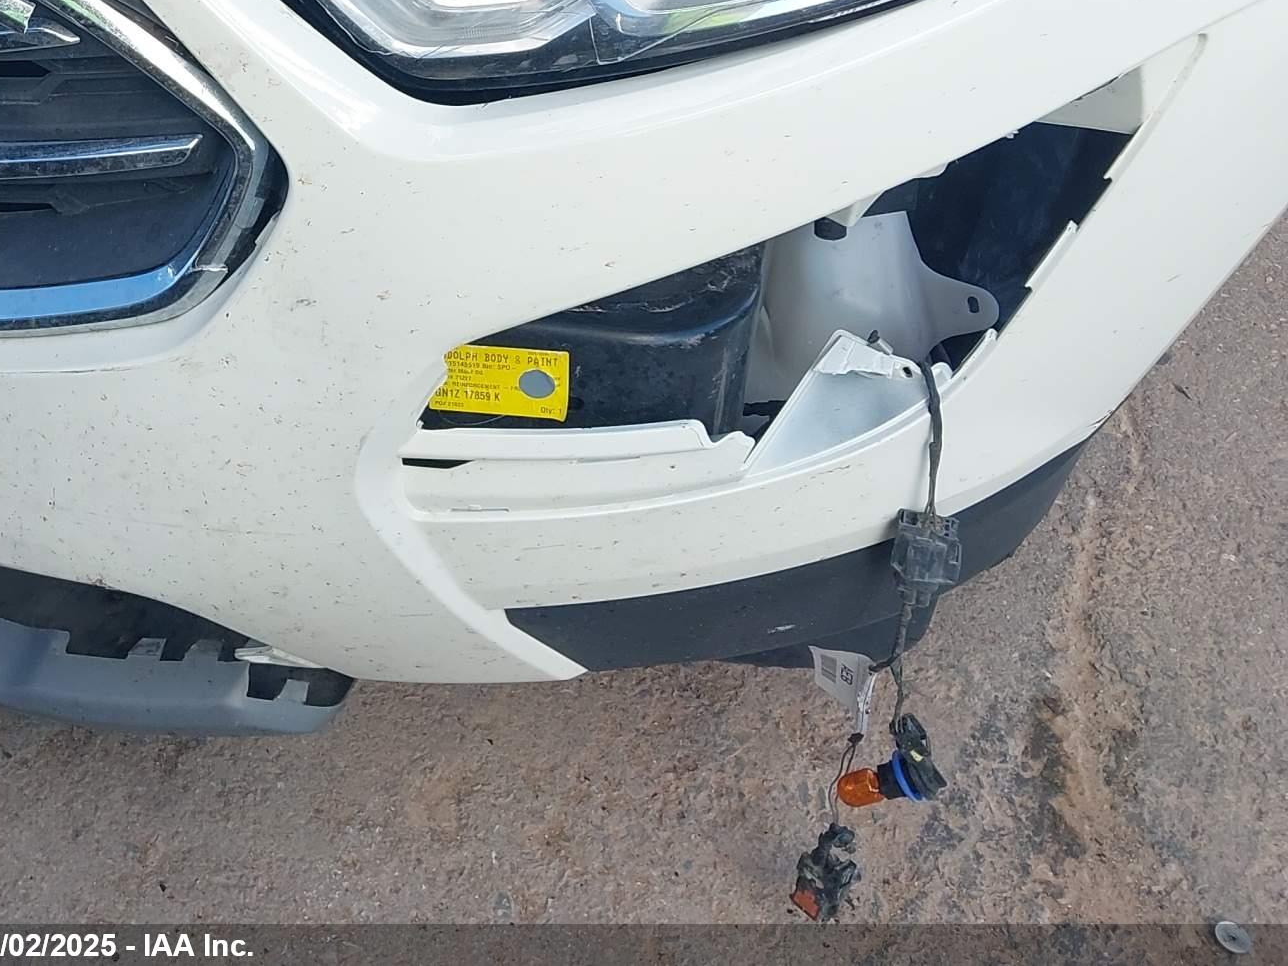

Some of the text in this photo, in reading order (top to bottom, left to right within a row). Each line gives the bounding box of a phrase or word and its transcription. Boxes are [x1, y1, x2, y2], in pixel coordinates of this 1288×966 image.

[484, 352, 509, 363] BODY
[527, 356, 559, 367] PAINT
[463, 391, 491, 402] 17859
[494, 392, 501, 403] K
